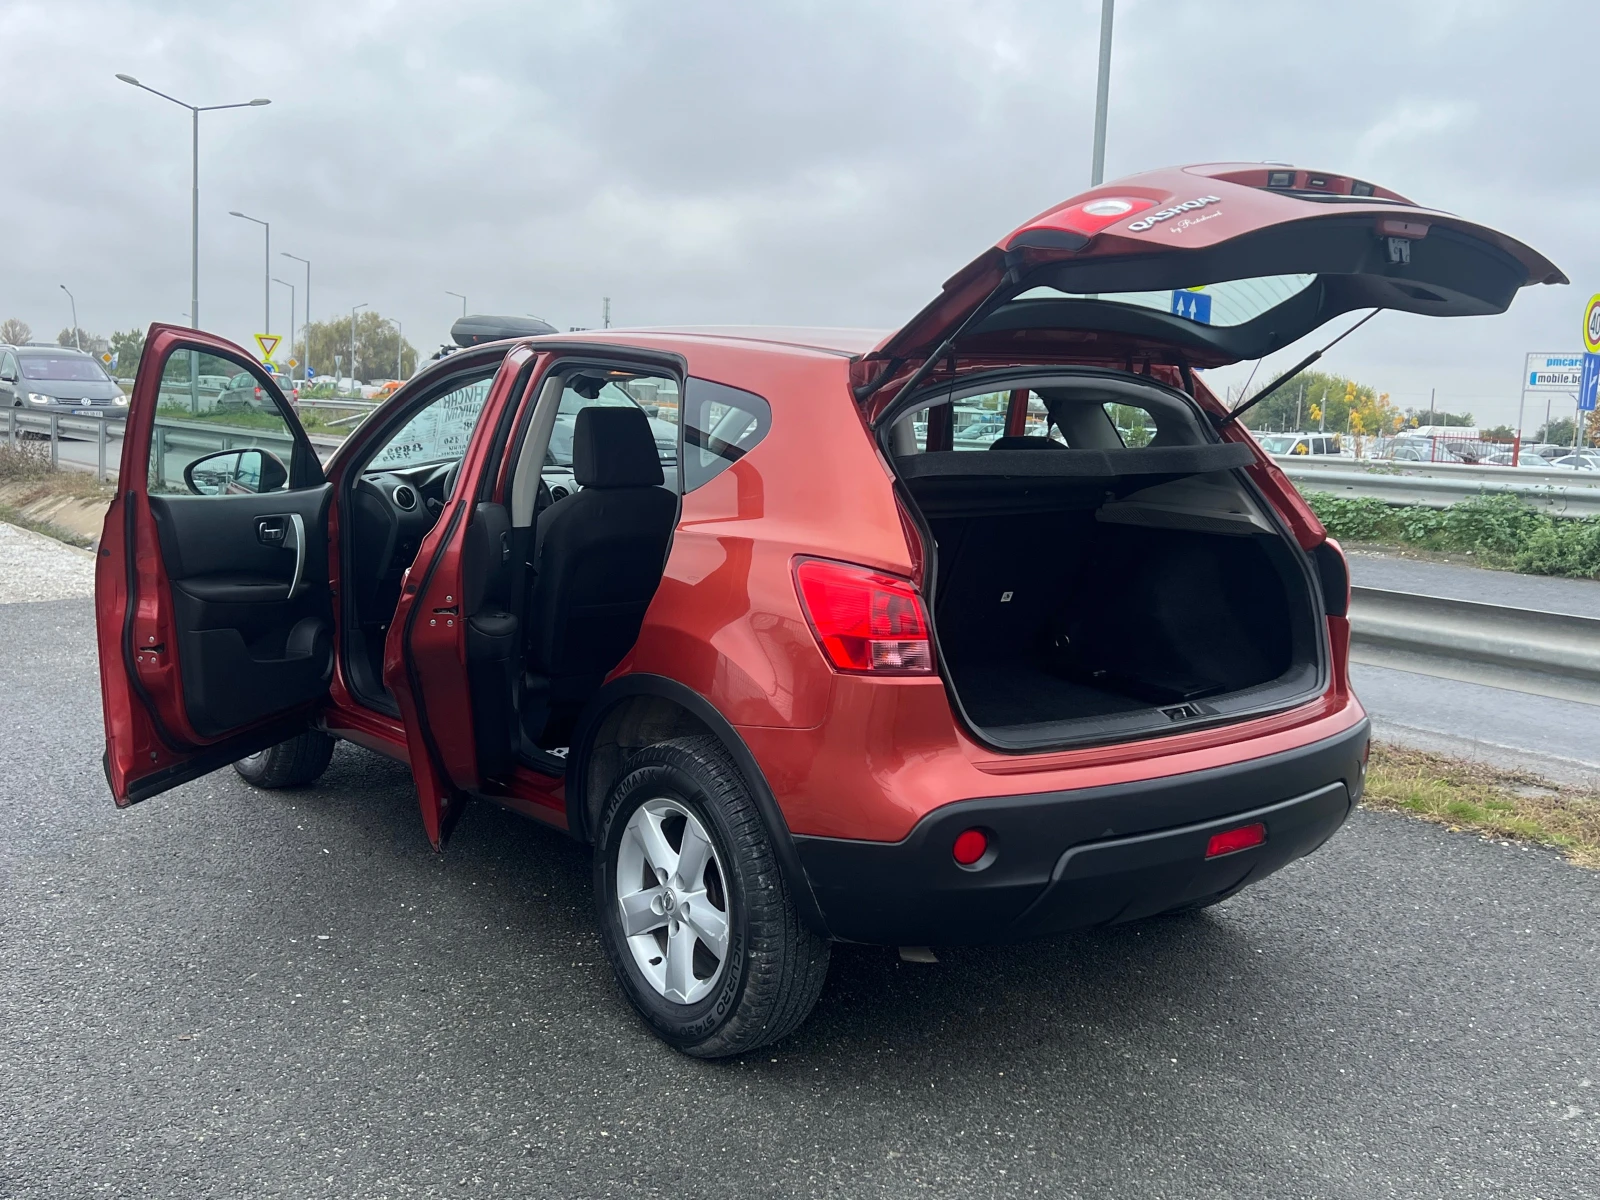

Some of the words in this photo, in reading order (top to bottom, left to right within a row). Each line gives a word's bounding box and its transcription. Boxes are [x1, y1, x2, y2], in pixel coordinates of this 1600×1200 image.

[1128, 195, 1221, 231] QASHQAI
[605, 769, 657, 825] STARMAXX
[716, 933, 742, 1015] INCURRO
[680, 1013, 715, 1036] ST430
